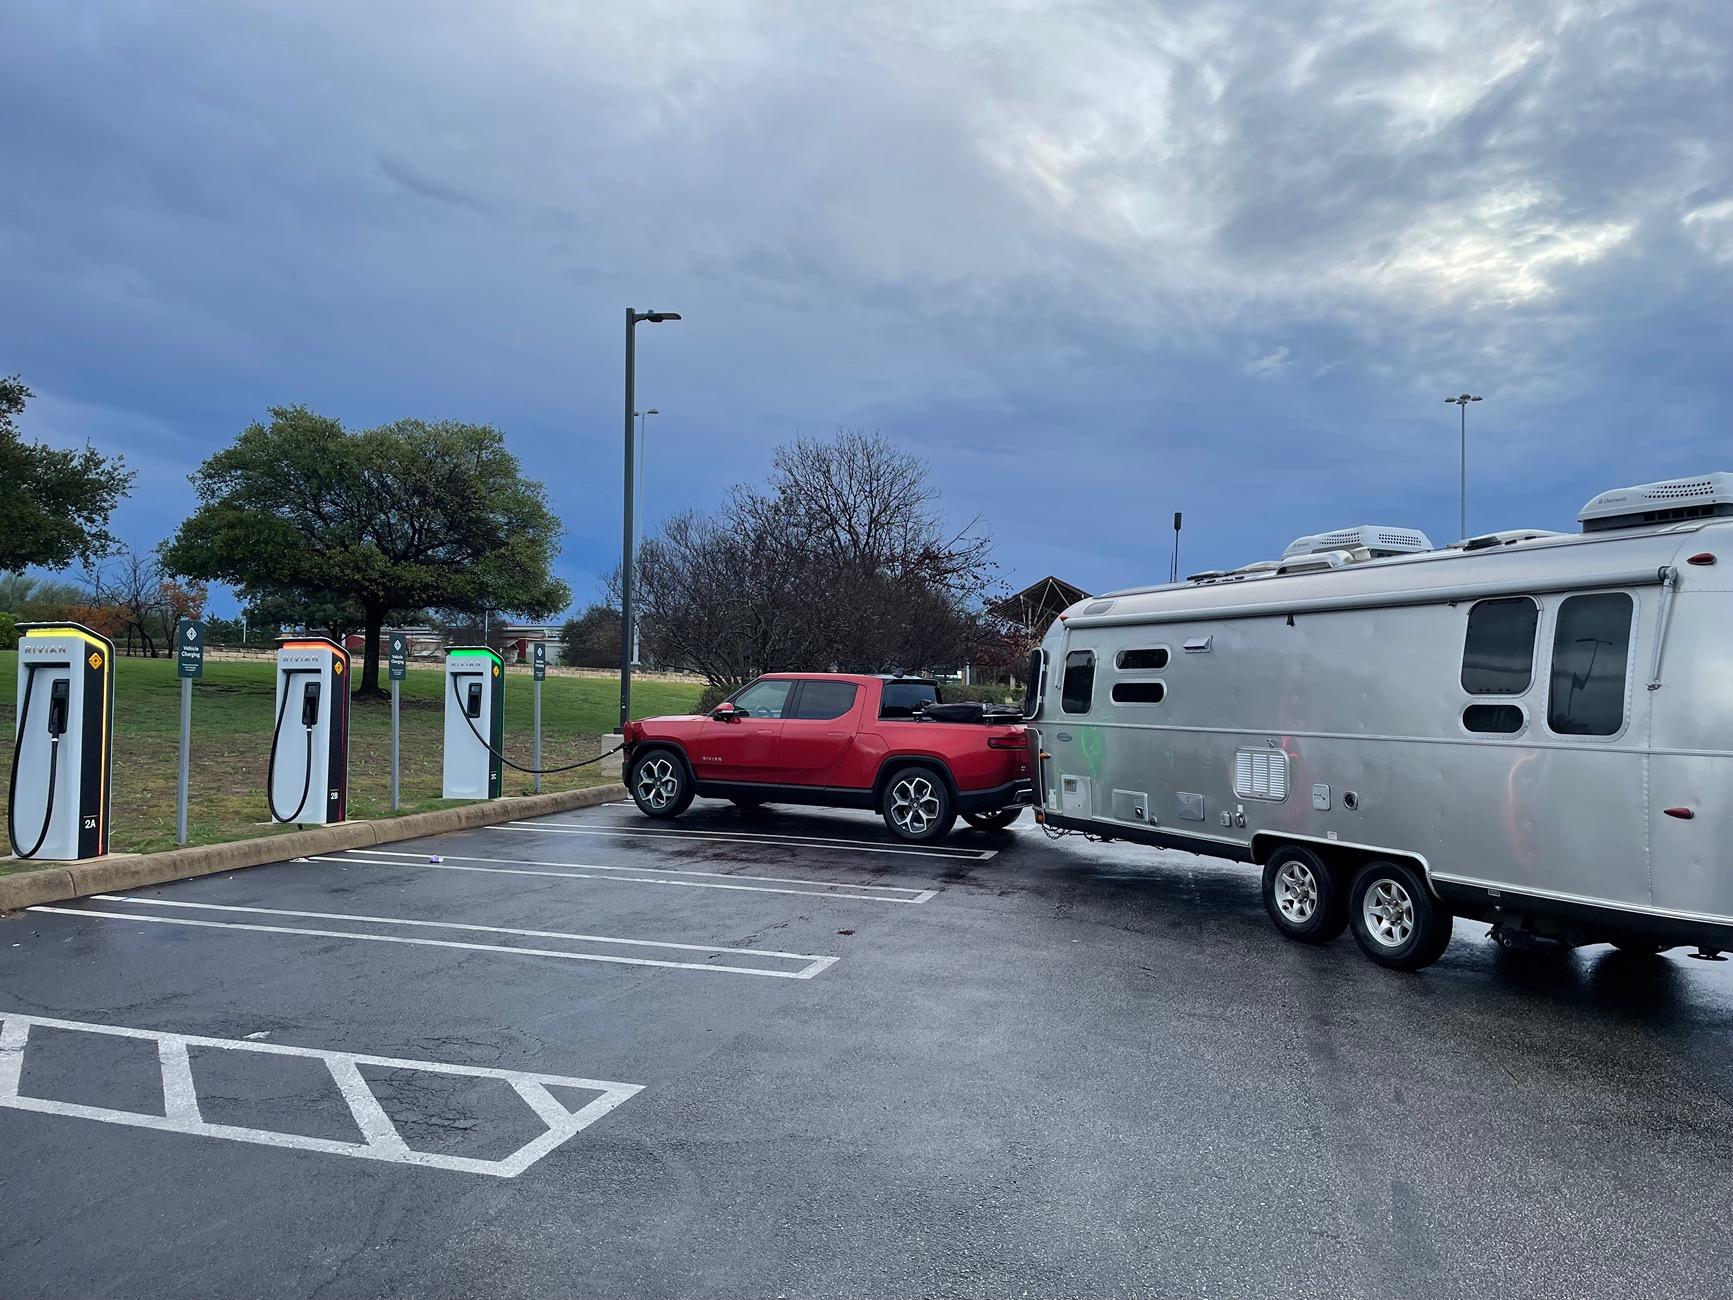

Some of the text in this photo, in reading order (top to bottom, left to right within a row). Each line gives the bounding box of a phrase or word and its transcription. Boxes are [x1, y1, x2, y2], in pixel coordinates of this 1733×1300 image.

[24, 645, 66, 654] RIVIAN
[181, 651, 201, 659] Charging
[84, 818, 97, 829] 2A
